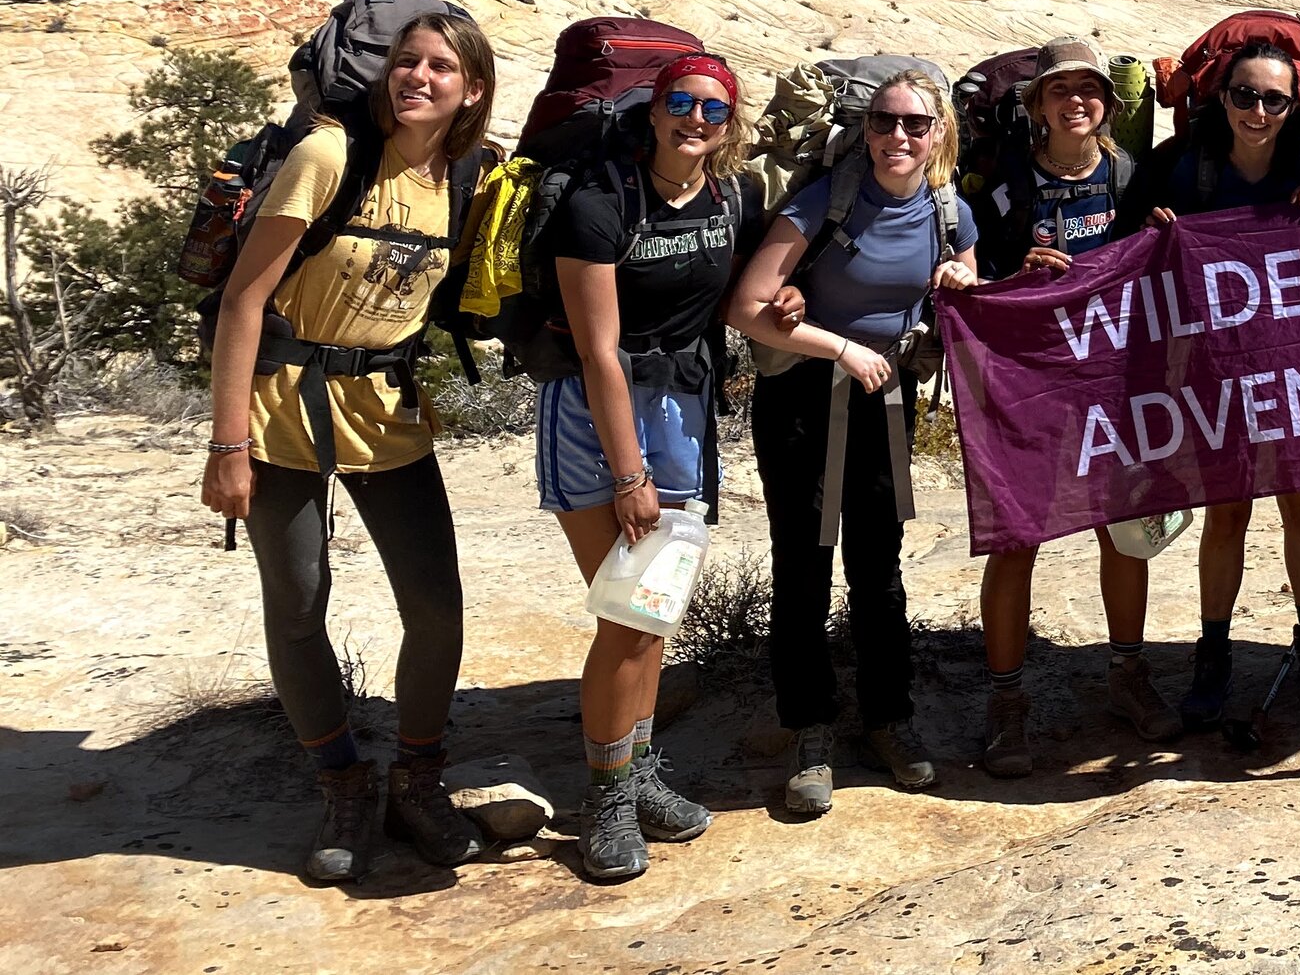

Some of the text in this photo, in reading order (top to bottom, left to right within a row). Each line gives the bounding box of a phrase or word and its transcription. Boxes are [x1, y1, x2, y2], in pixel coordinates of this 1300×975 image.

[1063, 216, 1084, 230] USA
[1064, 223, 1109, 240] CADEMY
[389, 248, 411, 265] STAT
